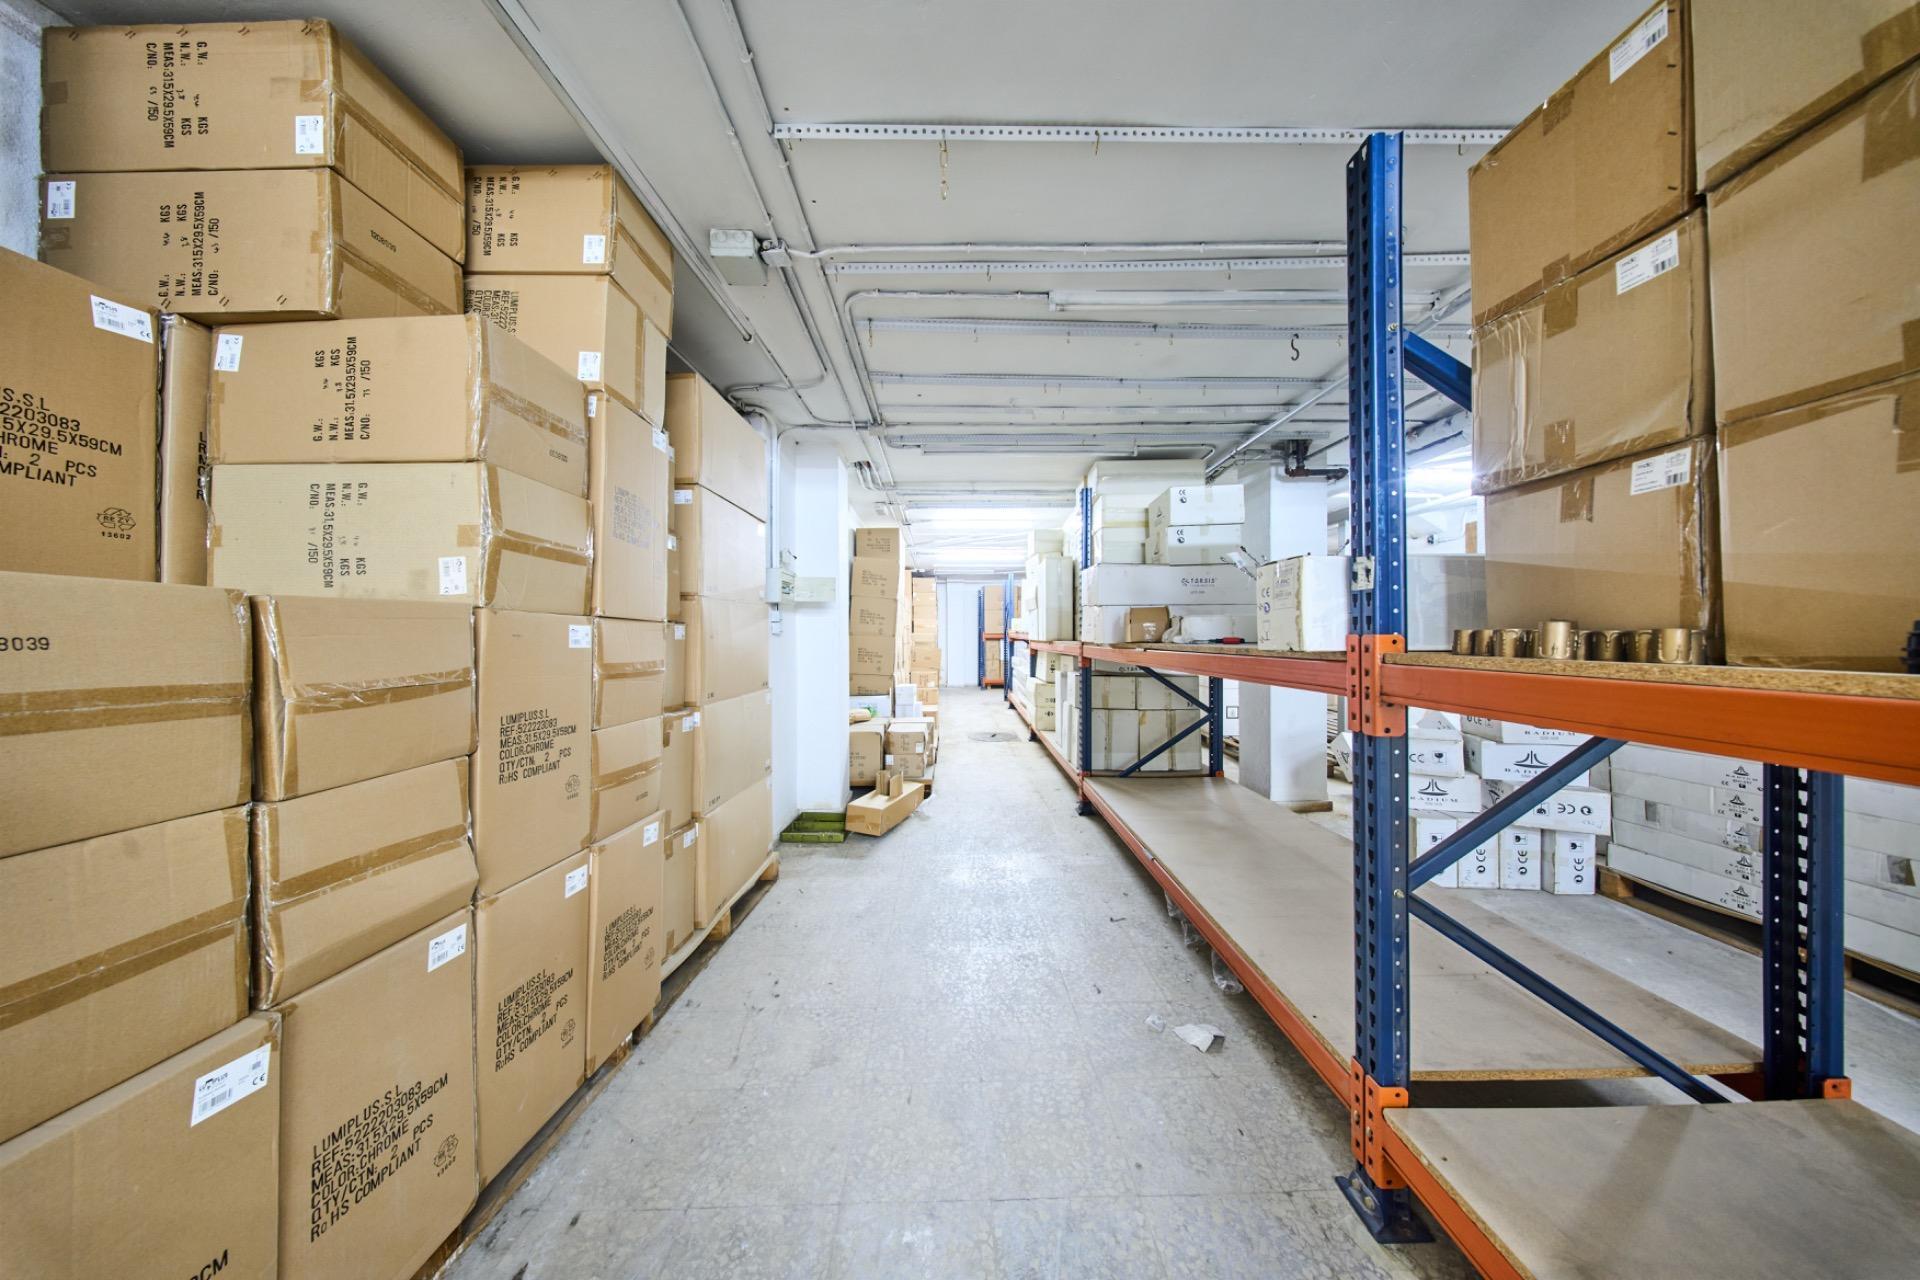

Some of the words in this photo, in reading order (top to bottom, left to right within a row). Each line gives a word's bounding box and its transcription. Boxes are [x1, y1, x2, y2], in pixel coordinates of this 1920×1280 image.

[146, 42, 157, 69] C/NO:
[181, 117, 192, 136] KGS
[197, 117, 208, 135] KGS
[160, 205, 171, 223] KGS
[176, 204, 187, 222] KGS
[497, 233, 506, 247] KGS
[510, 232, 518, 246] KGS
[208, 270, 219, 296] C/NO:
[315, 350, 325, 368] KGS
[330, 348, 340, 366] KGS
[360, 414, 370, 440] C/NO:
[29, 453, 41, 466] 2
[65, 459, 97, 477] PCS
[339, 558, 351, 576] KGS
[355, 557, 367, 575] KGS
[545, 751, 550, 762] 2
[559, 746, 572, 758] PCS
[523, 760, 560, 778] COMPLIANT
[1517, 850, 1528, 863] CE
[1574, 858, 1584, 872] CE
[520, 1013, 557, 1052] COMPLIANT
[312, 1073, 448, 1194] MEAS:31.5X29.5X59CM
[311, 1119, 410, 1209] COLOR:CHROME
[312, 1164, 378, 1224] QTY/CTN:
[391, 1145, 398, 1160] 2
[413, 1114, 433, 1140] PCS
[355, 1138, 422, 1204] COMPLIANT
